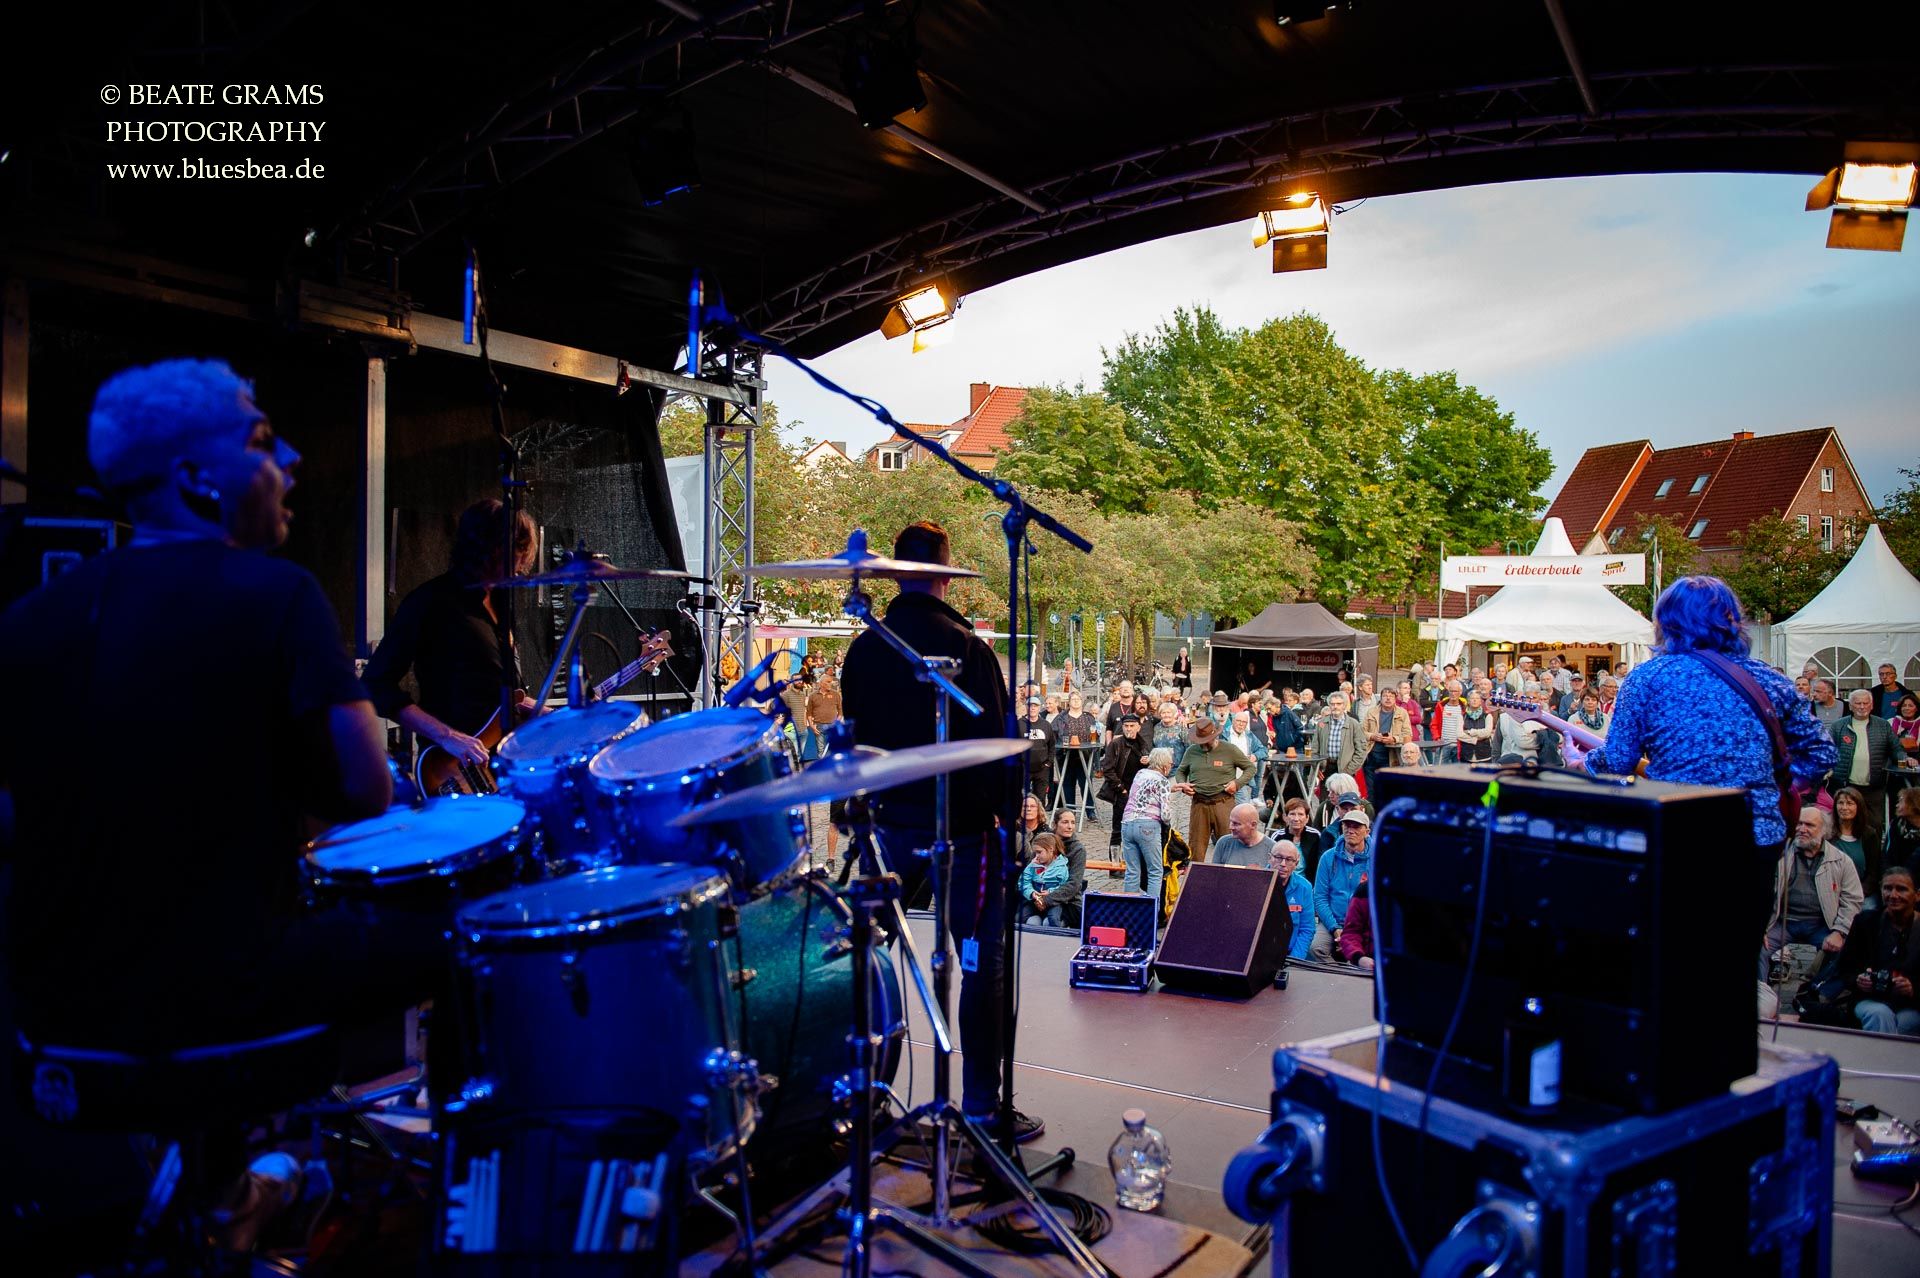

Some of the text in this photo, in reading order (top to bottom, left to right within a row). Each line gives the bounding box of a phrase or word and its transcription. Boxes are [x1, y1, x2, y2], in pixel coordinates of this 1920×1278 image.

[1458, 564, 1583, 575] LILLET Erdbeerbowle
[1276, 654, 1336, 663] rockradio.de
